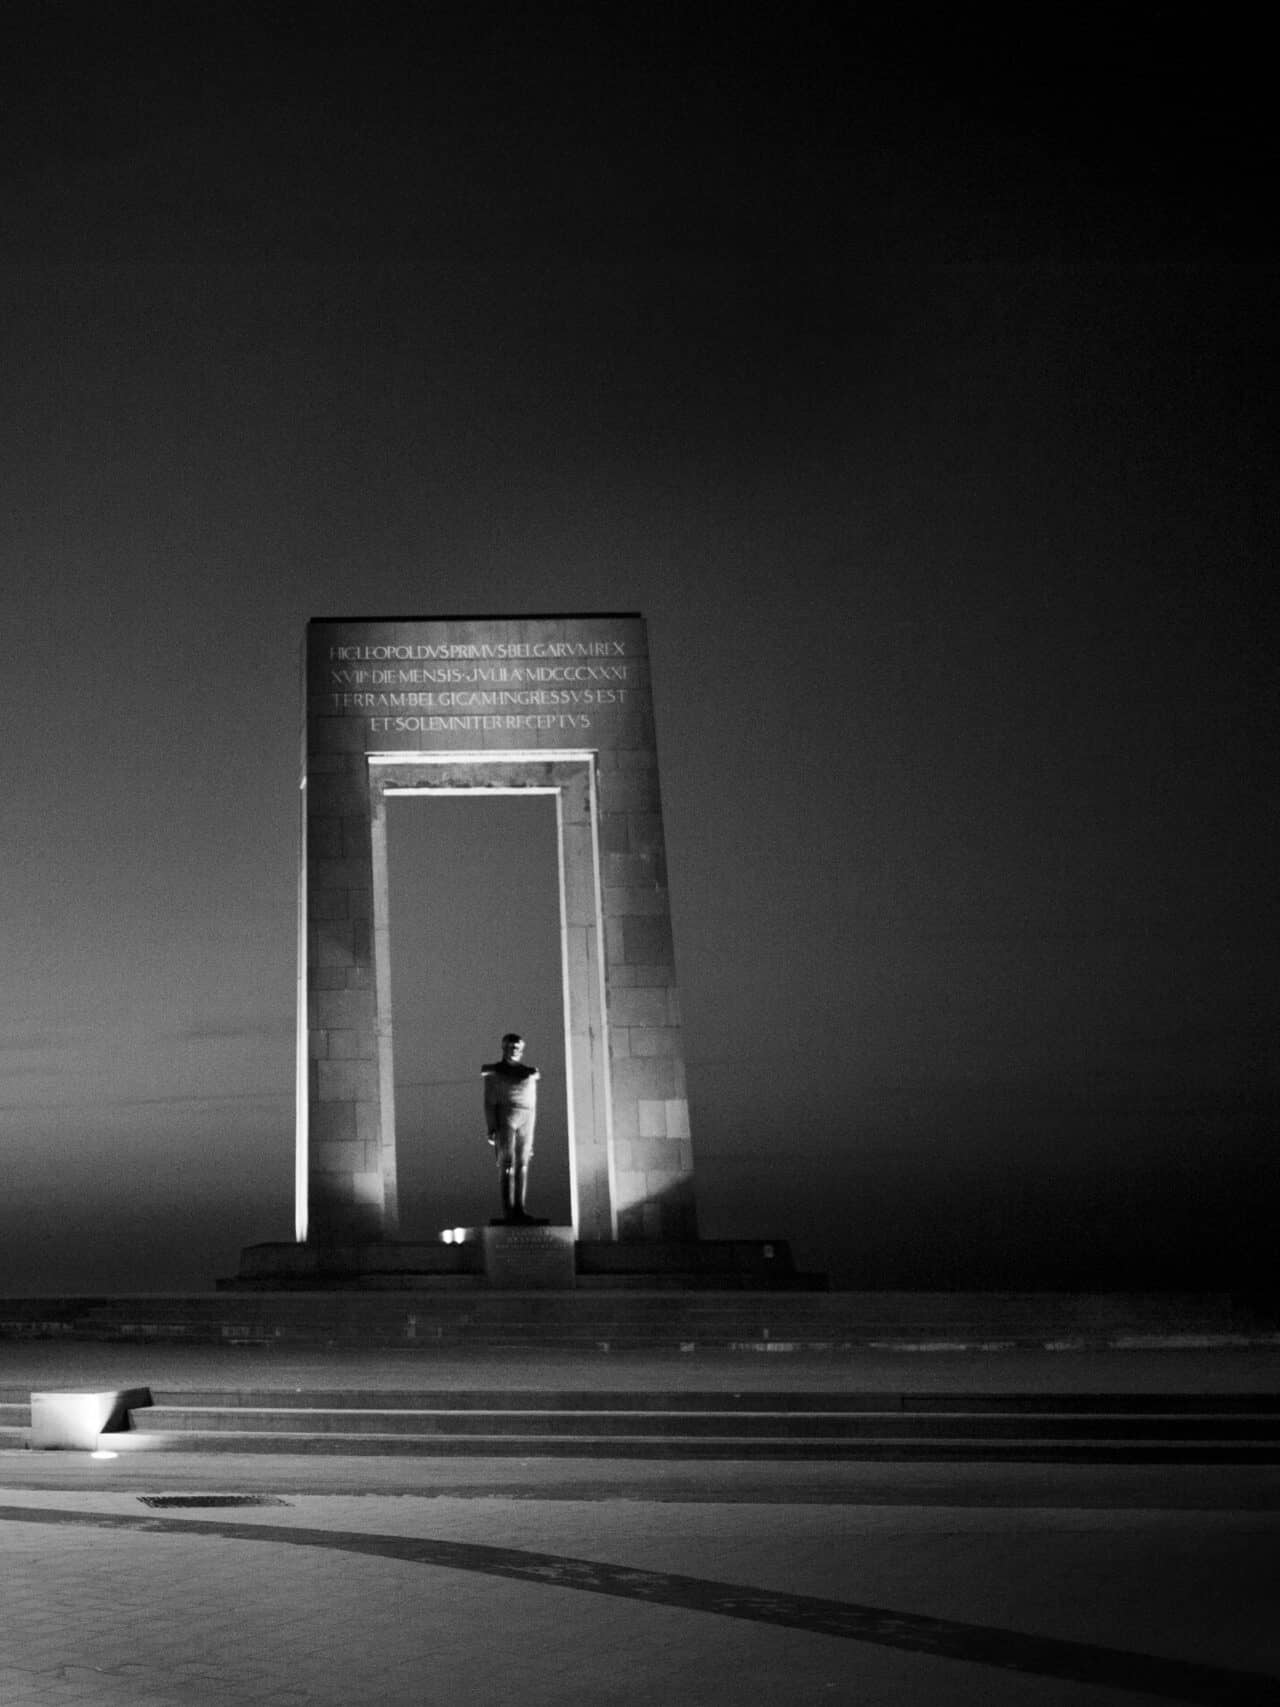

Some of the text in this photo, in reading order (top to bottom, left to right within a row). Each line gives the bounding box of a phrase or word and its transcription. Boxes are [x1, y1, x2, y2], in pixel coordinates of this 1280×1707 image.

[450, 644, 506, 658] PRIMVS
[595, 642, 625, 656] REX
[372, 669, 396, 684] DIE
[332, 689, 627, 707] TERRAM BELGICAM INGRESSVS EST
[370, 714, 592, 732] ET SOLEMNITER RECEPTVS
